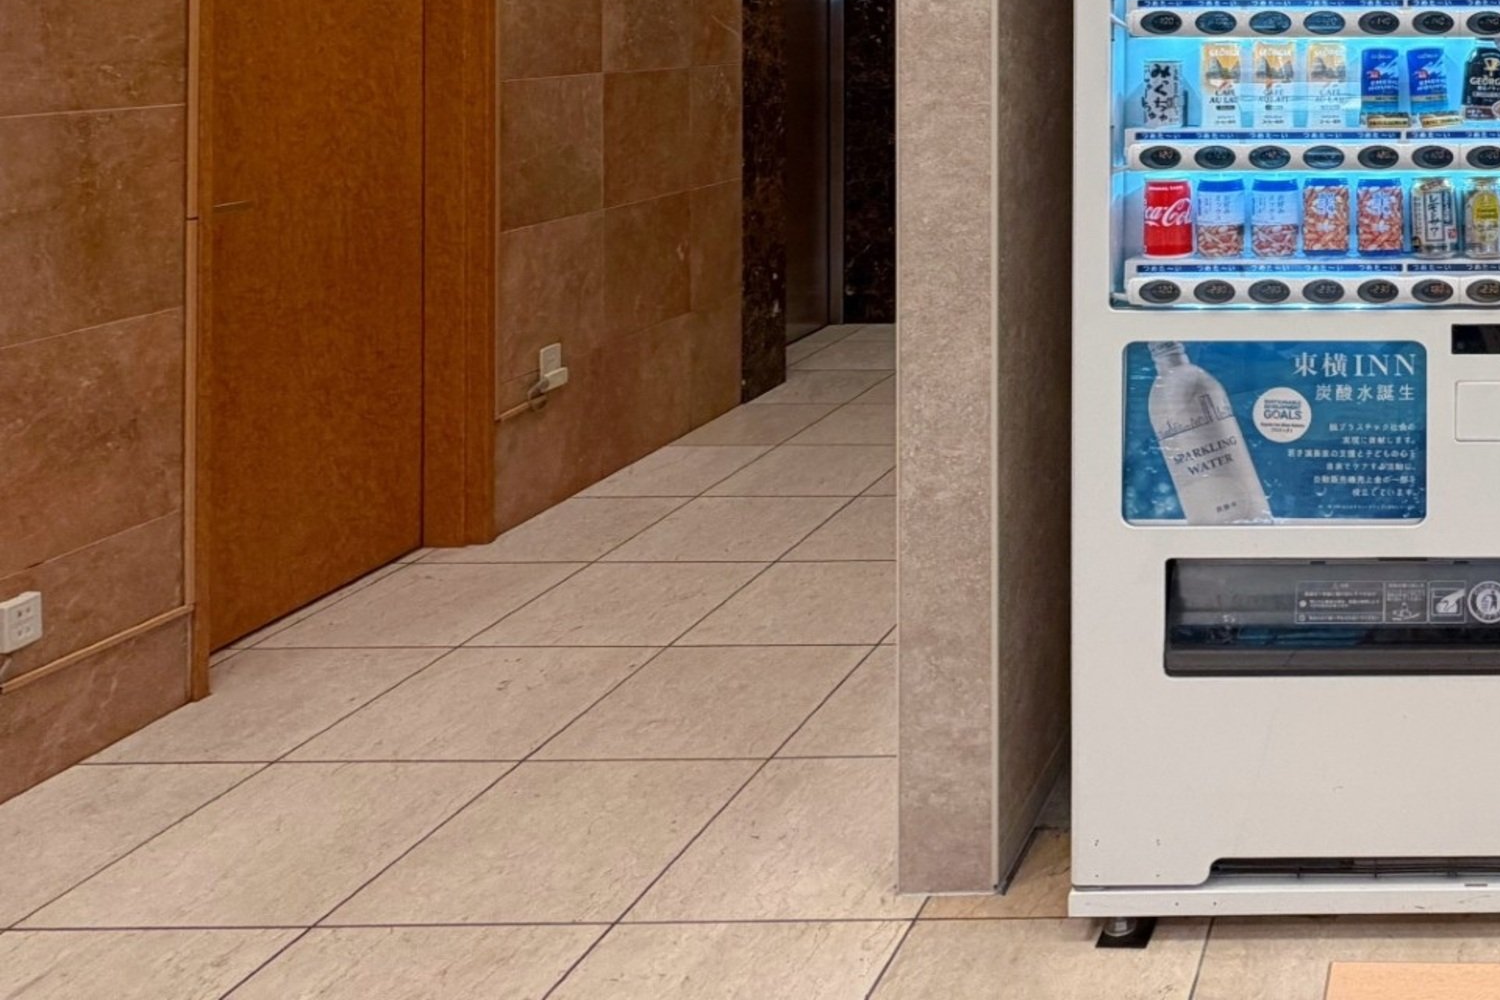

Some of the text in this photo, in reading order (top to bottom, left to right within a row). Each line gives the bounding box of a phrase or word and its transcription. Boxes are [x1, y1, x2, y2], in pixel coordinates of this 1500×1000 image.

[1293, 352, 1416, 377] 東横INN
[1315, 384, 1416, 402] 炭酸水誕生
[1264, 410, 1302, 419] GOALS
[1174, 436, 1237, 464] SPARKLING
[1188, 453, 1234, 475] WATER
